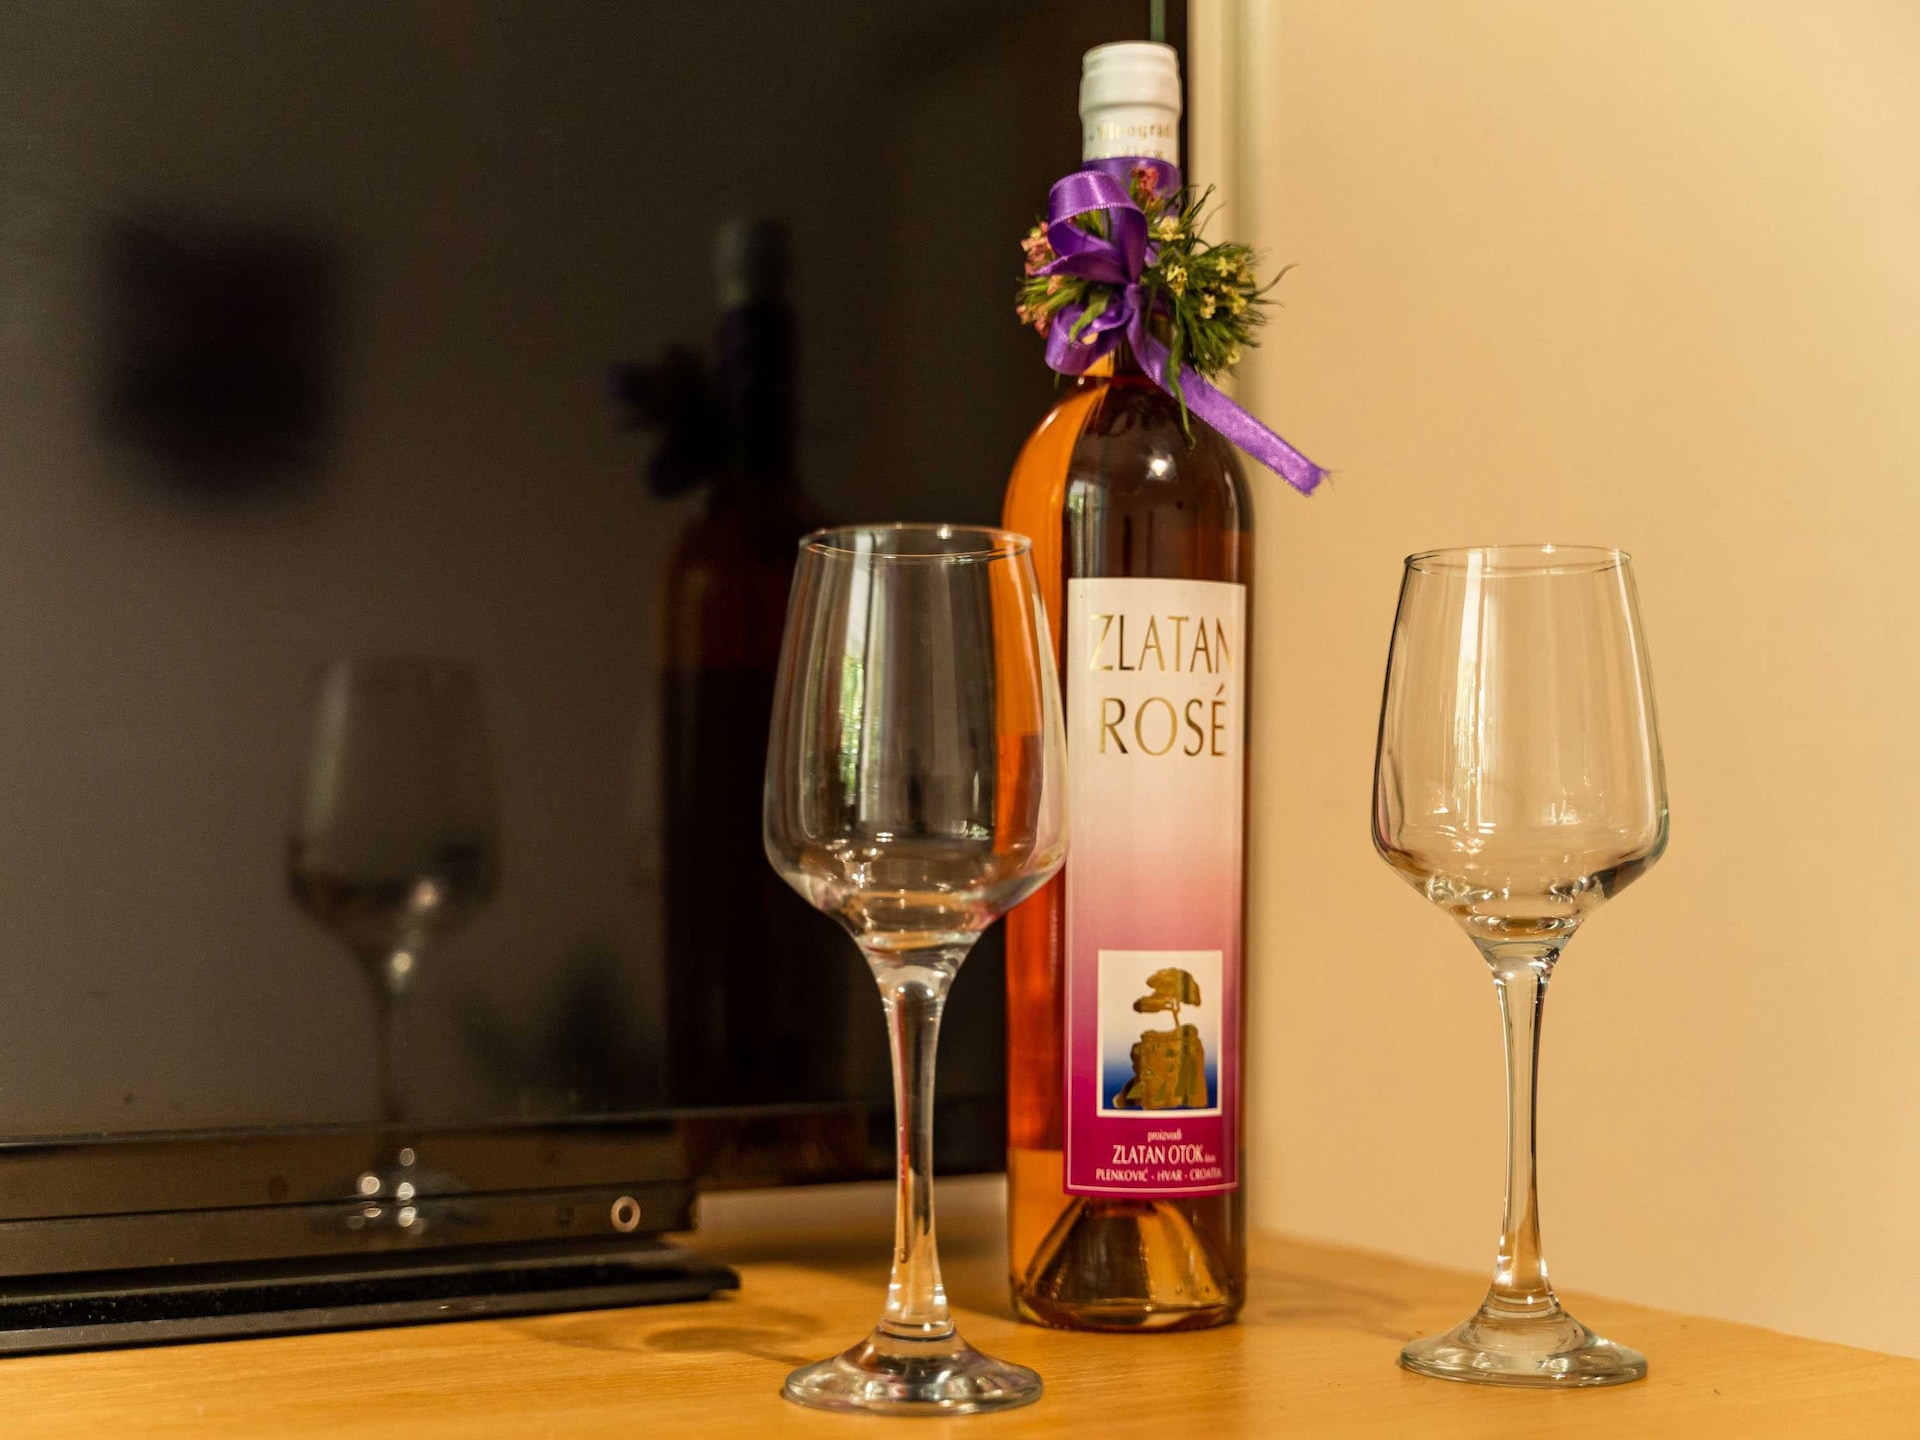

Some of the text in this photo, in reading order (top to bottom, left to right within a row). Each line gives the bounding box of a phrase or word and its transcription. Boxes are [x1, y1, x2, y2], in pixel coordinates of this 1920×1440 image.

[1089, 614, 1235, 674] ZLATAN
[1099, 683, 1226, 757] ROSÉ
[1096, 1166, 1224, 1182] PLENKOVIĆ HVAR CROATIA
[1112, 1144, 1166, 1165] ZLATAN
[1168, 1144, 1204, 1165] OTOK
